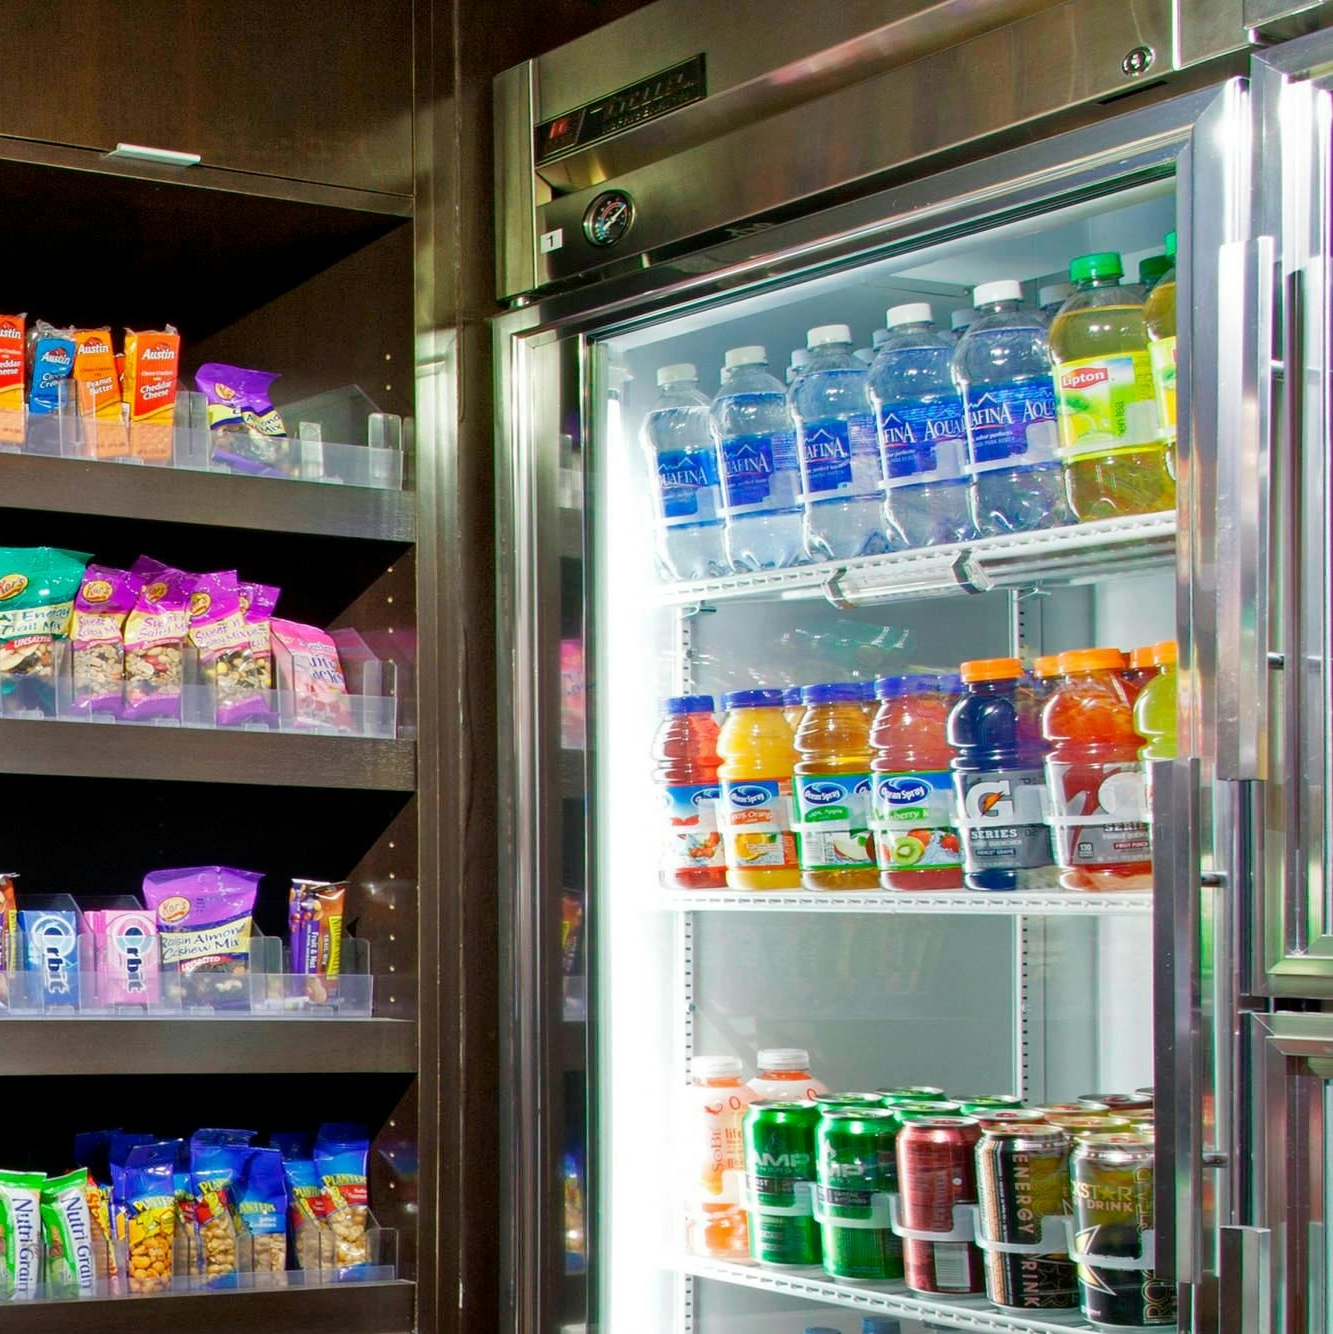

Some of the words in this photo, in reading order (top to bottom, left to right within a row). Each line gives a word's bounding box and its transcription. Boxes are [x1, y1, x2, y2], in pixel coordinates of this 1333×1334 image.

[547, 235, 554, 248] 1
[77, 342, 109, 354] Austin
[141, 348, 175, 360] Austin
[40, 351, 71, 365] Austin
[85, 376, 113, 388] Peanut
[1061, 368, 1106, 388] Lipton
[88, 384, 115, 396] Butter
[140, 381, 172, 394] Cheddar
[143, 389, 170, 401] Cheese
[85, 582, 112, 597] Kar's
[42, 620, 62, 632] Mix
[746, 792, 766, 805] Spray
[821, 788, 840, 803] Spray
[900, 785, 925, 801] Spray
[971, 828, 1018, 840] SERIES
[162, 901, 190, 916] Kar's
[162, 934, 191, 949] Raisin
[193, 922, 246, 944] Almond
[311, 931, 319, 949] Fruit
[162, 944, 210, 960] Cashew
[215, 937, 240, 950] Mix
[41, 925, 69, 994] Orbit
[123, 926, 145, 993] Orbit
[1013, 1153, 1034, 1236] ENERGY
[1087, 1200, 1133, 1212] DRINK
[13, 1198, 33, 1248] Nutri
[64, 1196, 85, 1242] Nutri
[76, 1244, 93, 1289] Grain
[18, 1249, 33, 1292] Grain
